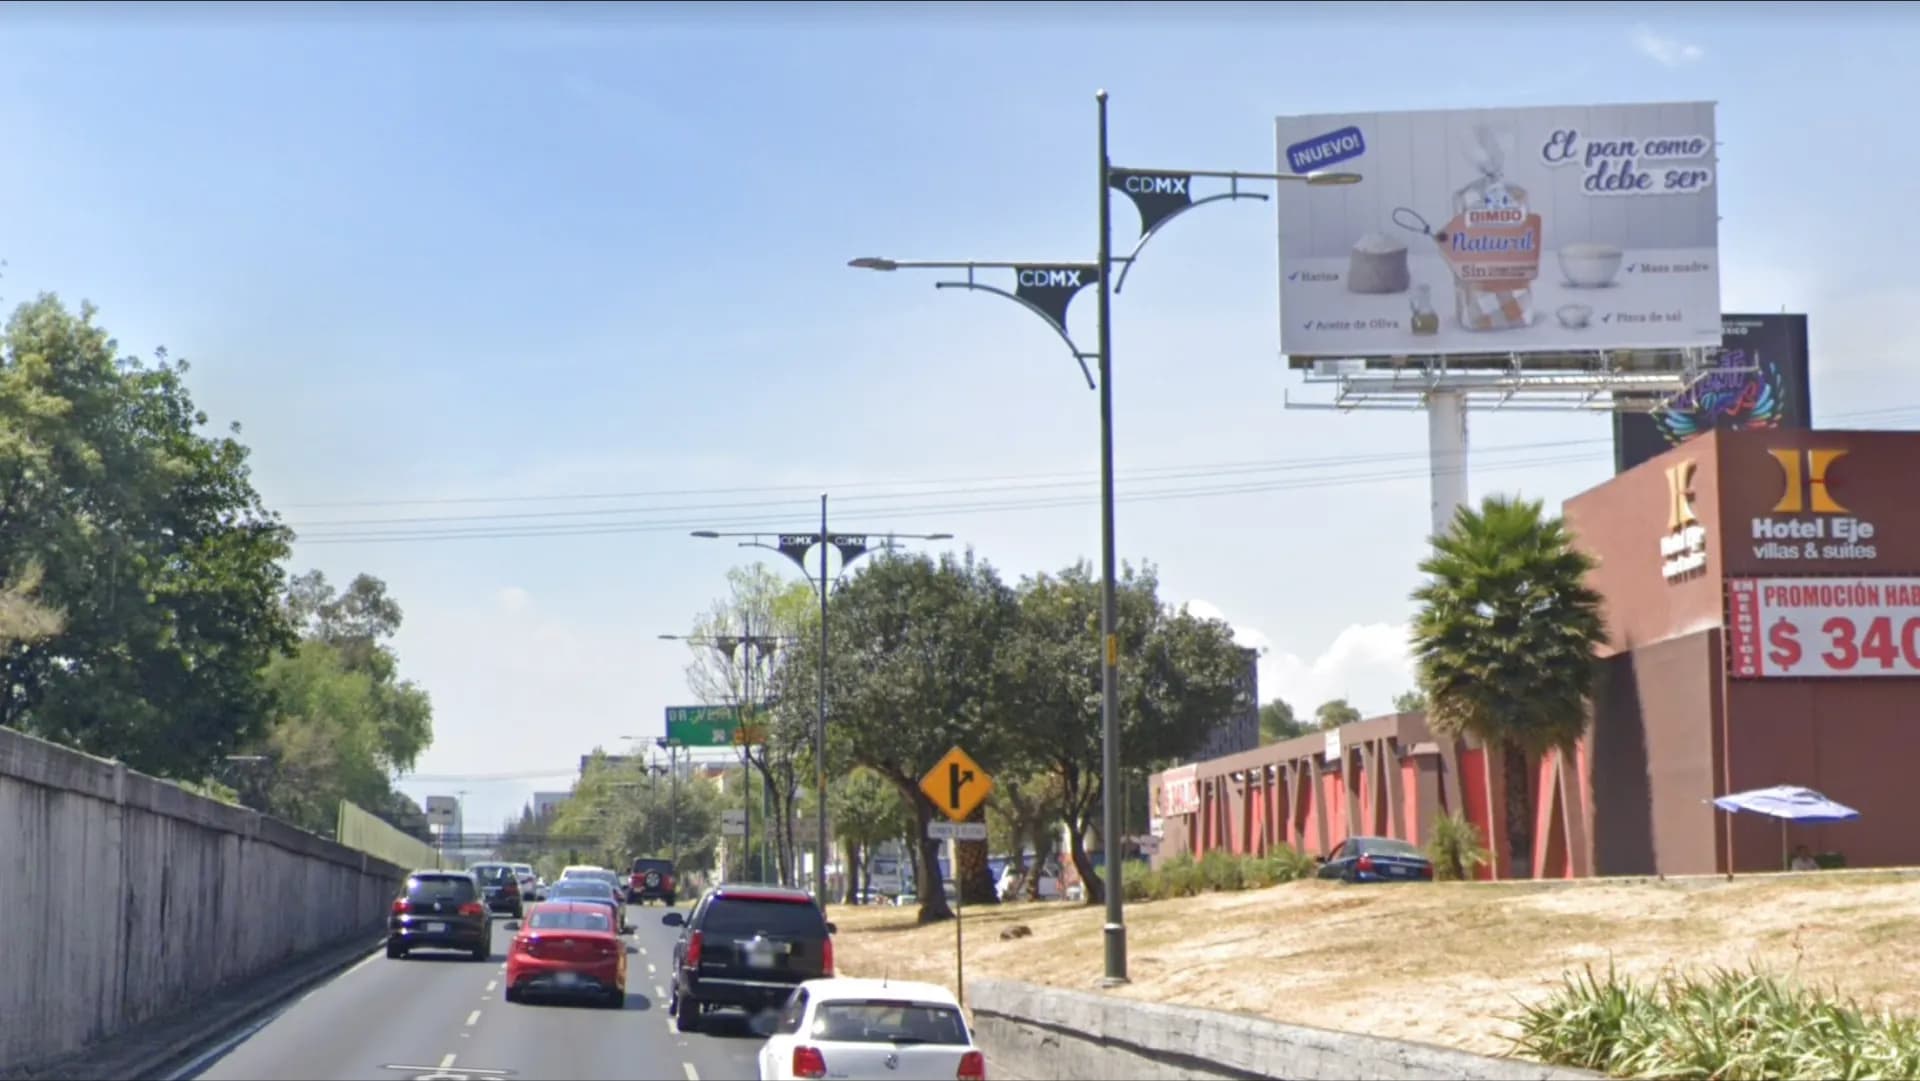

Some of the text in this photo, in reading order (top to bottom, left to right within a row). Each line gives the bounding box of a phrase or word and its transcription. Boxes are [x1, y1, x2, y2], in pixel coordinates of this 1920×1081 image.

[1293, 133, 1360, 167] ¡NUEVO!
[1543, 129, 1706, 168] El pan como
[1126, 176, 1186, 194] CDMX
[1584, 160, 1707, 191] debe ser
[1452, 230, 1533, 252] Natural
[1019, 270, 1081, 287] CDMX
[1353, 319, 1365, 328] de
[1369, 319, 1399, 328] Oliva
[1752, 517, 1874, 543] Hotel Eje
[781, 536, 813, 545] CDMX
[835, 536, 866, 545] CDMX
[1752, 542, 1877, 559] villas & suites
[1764, 582, 1879, 607] PROMOCIÓN
